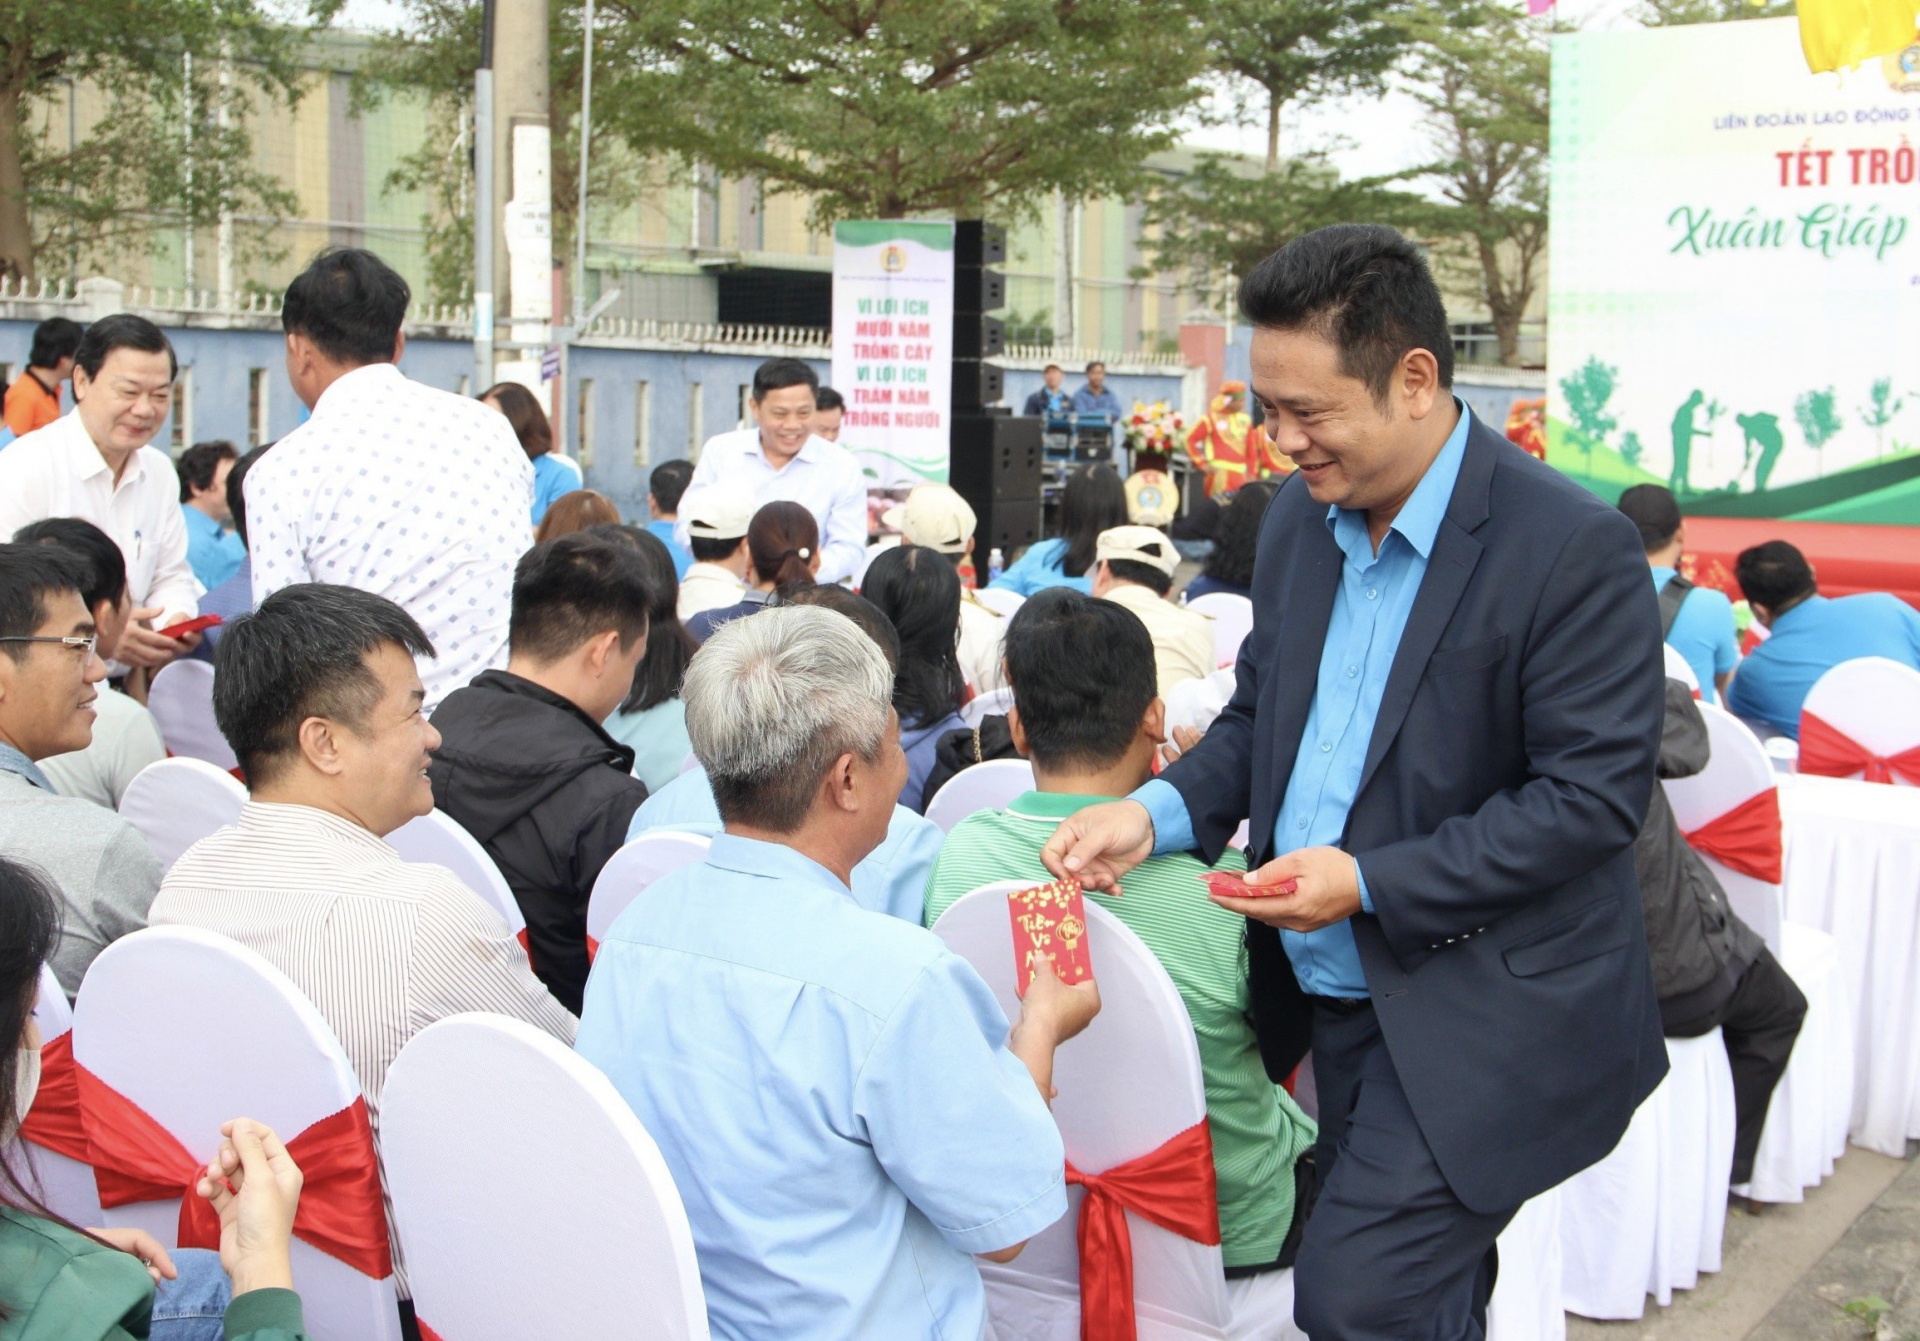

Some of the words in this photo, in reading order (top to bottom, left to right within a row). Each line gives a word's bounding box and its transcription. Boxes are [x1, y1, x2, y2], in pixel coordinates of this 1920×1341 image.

[1714, 111, 1748, 129] LIÊN
[1755, 108, 1806, 127] ĐOÀN
[1814, 110, 1848, 124] LAO
[1855, 106, 1911, 126] ĐỘNG
[1776, 136, 1833, 187] TẾT
[1847, 132, 1920, 185] TRỒ
[1667, 205, 1786, 257] Xuân
[1797, 203, 1909, 261] Giáp
